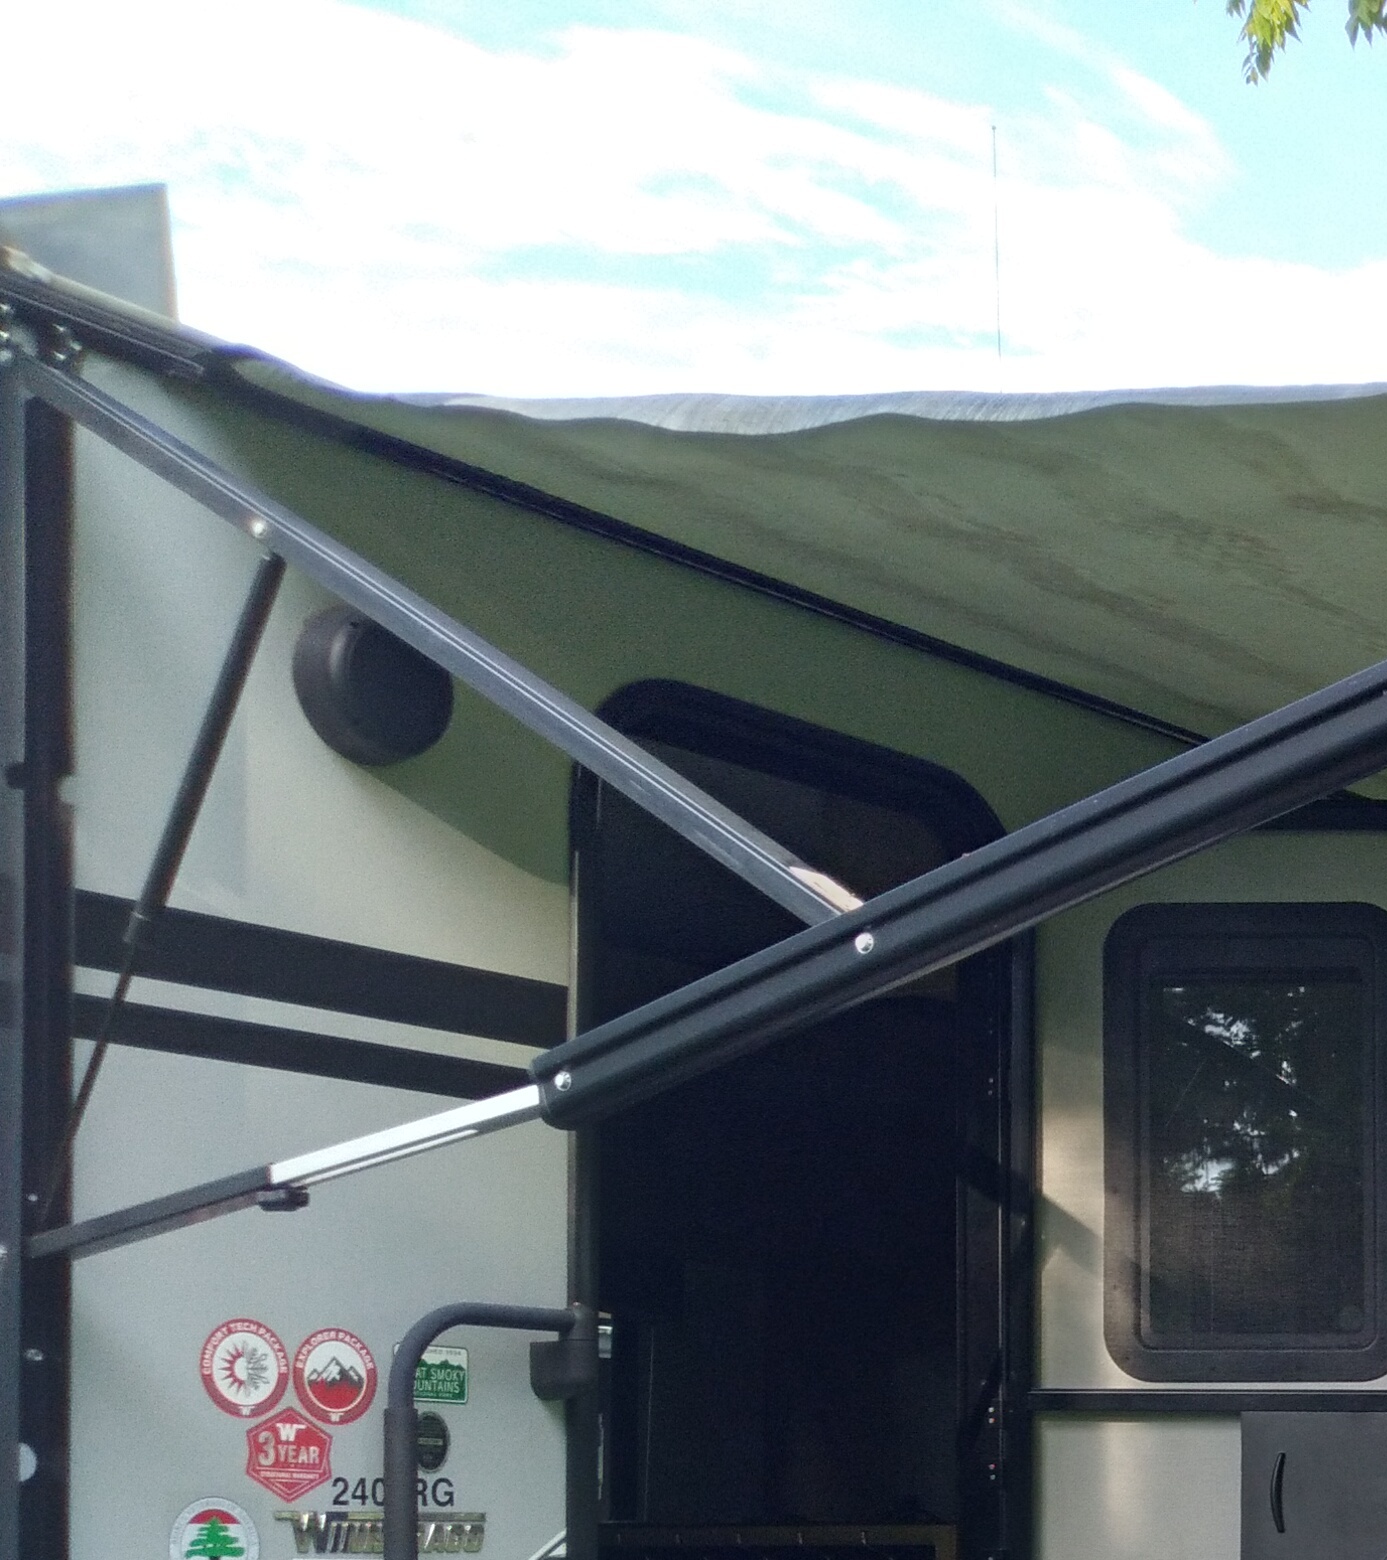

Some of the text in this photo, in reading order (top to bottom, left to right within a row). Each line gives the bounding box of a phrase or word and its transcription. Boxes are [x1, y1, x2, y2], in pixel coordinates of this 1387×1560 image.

[202, 1322, 288, 1375] COMFORT TECH PACKAGE
[295, 1331, 374, 1370] EXPLORER PACKAGE
[414, 1380, 460, 1394] UNTAINS
[430, 1368, 465, 1382] SMOKY
[258, 1431, 320, 1466] 3 YEAR
[332, 1477, 454, 1507] 240RG
